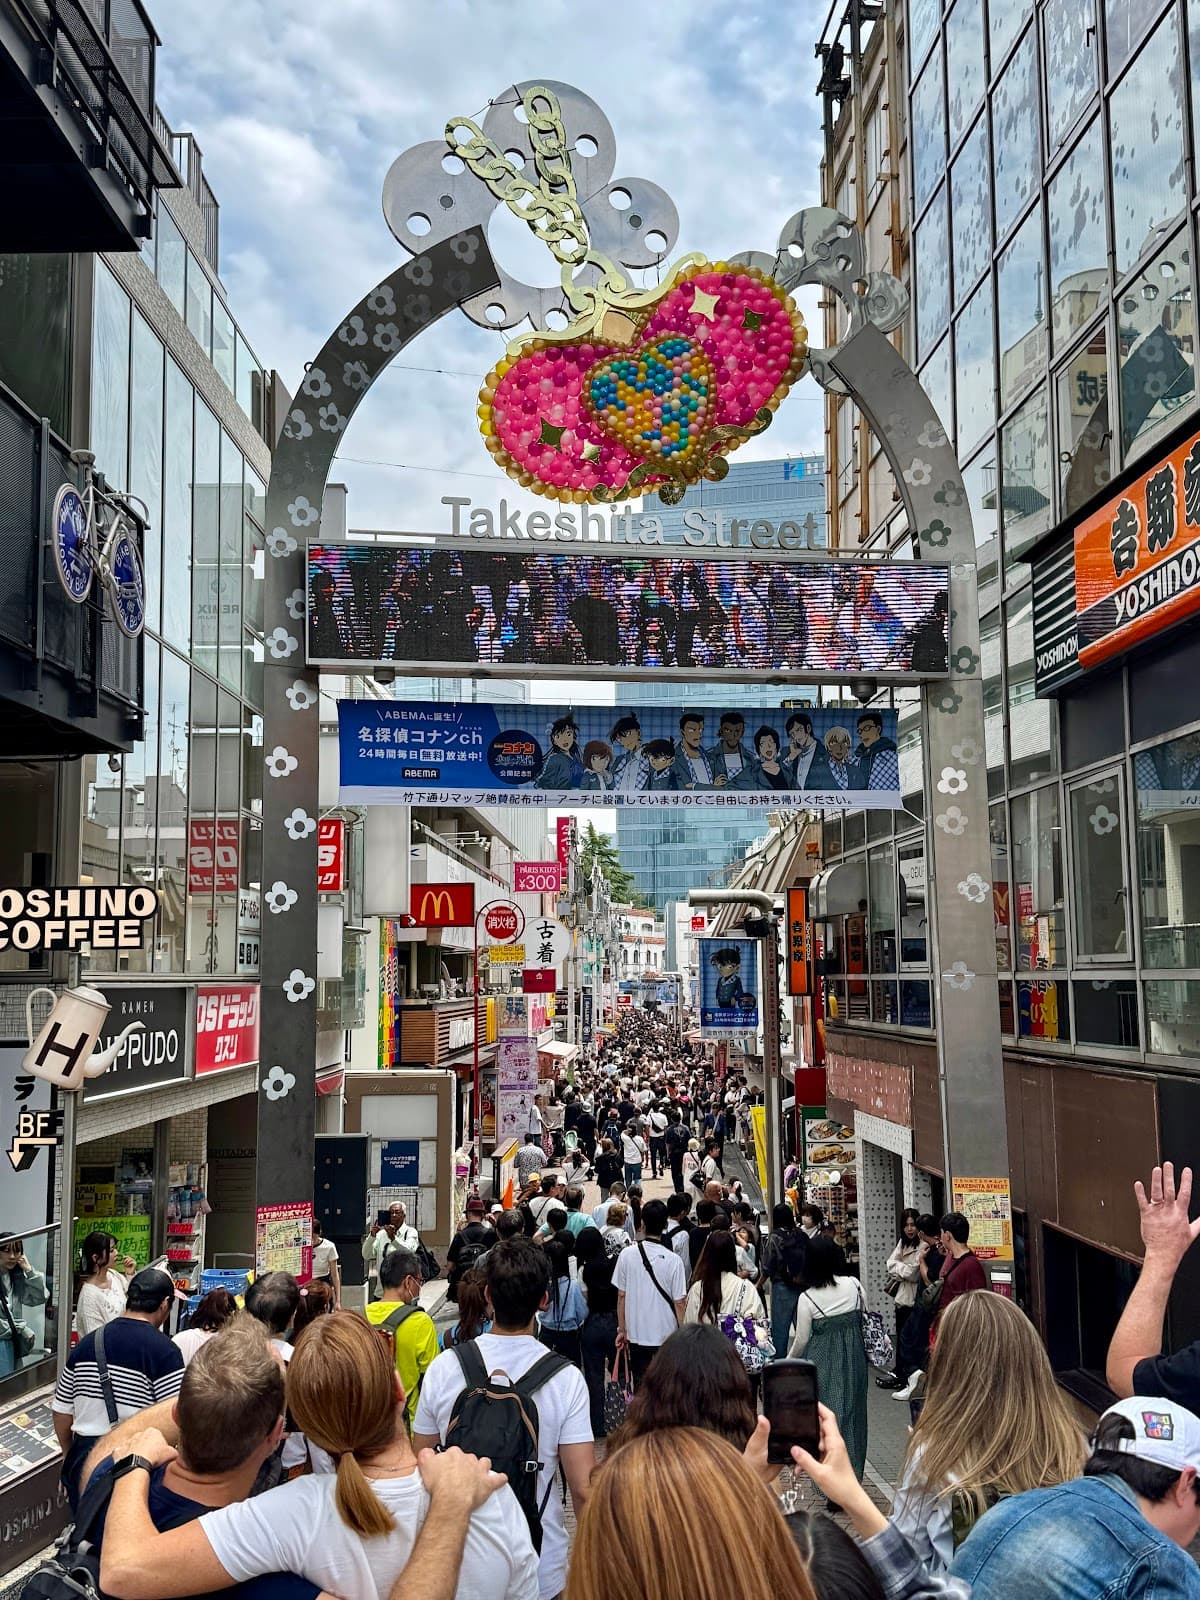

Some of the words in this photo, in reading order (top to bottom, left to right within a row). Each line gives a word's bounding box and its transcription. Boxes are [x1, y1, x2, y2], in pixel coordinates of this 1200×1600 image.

[441, 496, 664, 545] Takeshita
[682, 508, 822, 549] Street
[1037, 634, 1079, 674] YOSHINOY
[404, 769, 437, 778] ABEMA
[519, 875, 556, 890] ¥300
[488, 916, 515, 929] 消火栓
[536, 920, 555, 963] 古着
[121, 1000, 155, 1014] RAMEN
[34, 1022, 89, 1077] H
[214, 1034, 239, 1064] クスリ
[19, 1113, 50, 1138] BF
